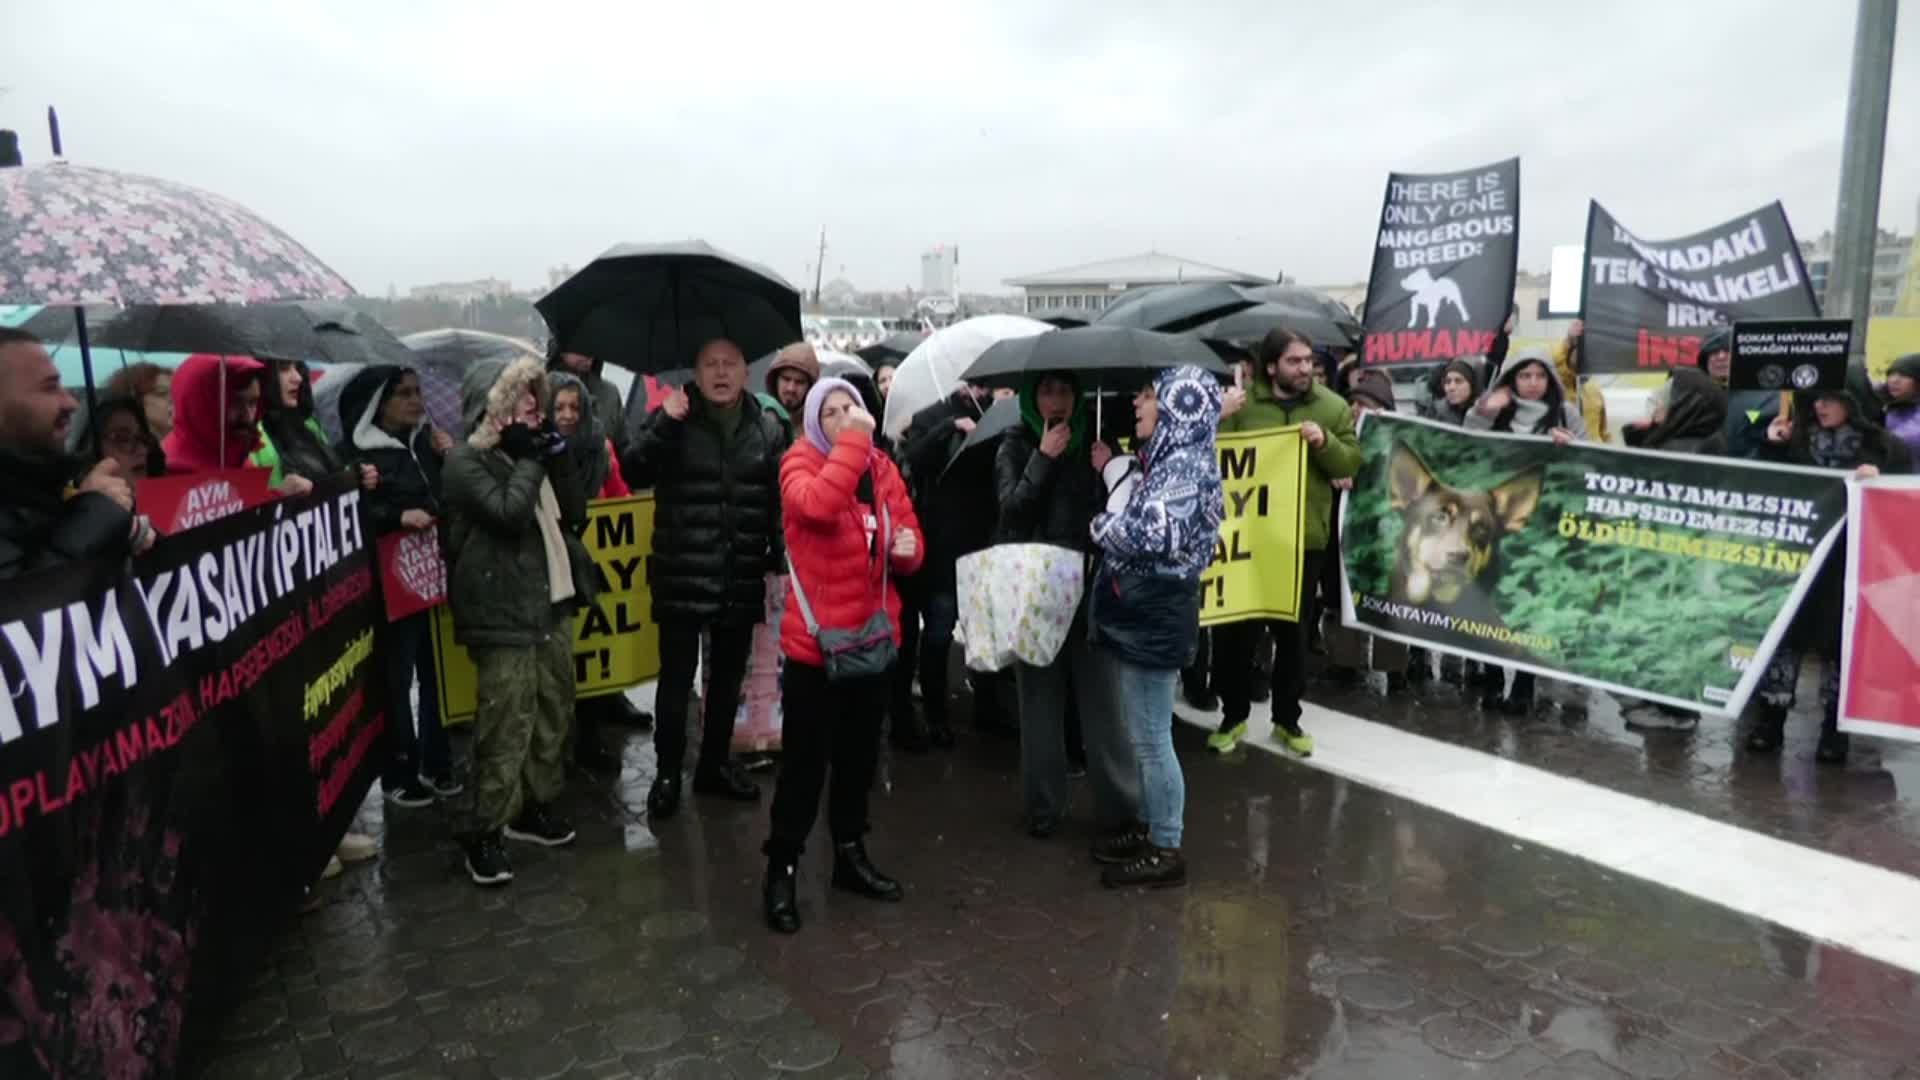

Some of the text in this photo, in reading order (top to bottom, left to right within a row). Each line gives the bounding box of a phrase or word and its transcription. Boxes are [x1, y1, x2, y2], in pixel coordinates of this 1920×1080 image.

[1391, 171, 1501, 201] THERE IS
[1385, 190, 1506, 225] ONLY ONE
[1591, 256, 1649, 287] TEK
[1637, 328, 1704, 368] İNS
[1737, 331, 1849, 343] SOKAK HAYVANLARI
[1790, 343, 1844, 354] HALKIDIR
[1219, 447, 1256, 480] M
[187, 480, 229, 513] AYM
[1211, 484, 1269, 521] YI
[1584, 471, 1819, 521] TOPLAYAMAZSIN.
[1586, 495, 1814, 545] HAPSEDEMEZSİN.
[134, 531, 268, 667] YASAYI
[272, 502, 339, 598] İPTAL
[337, 489, 363, 558] ET
